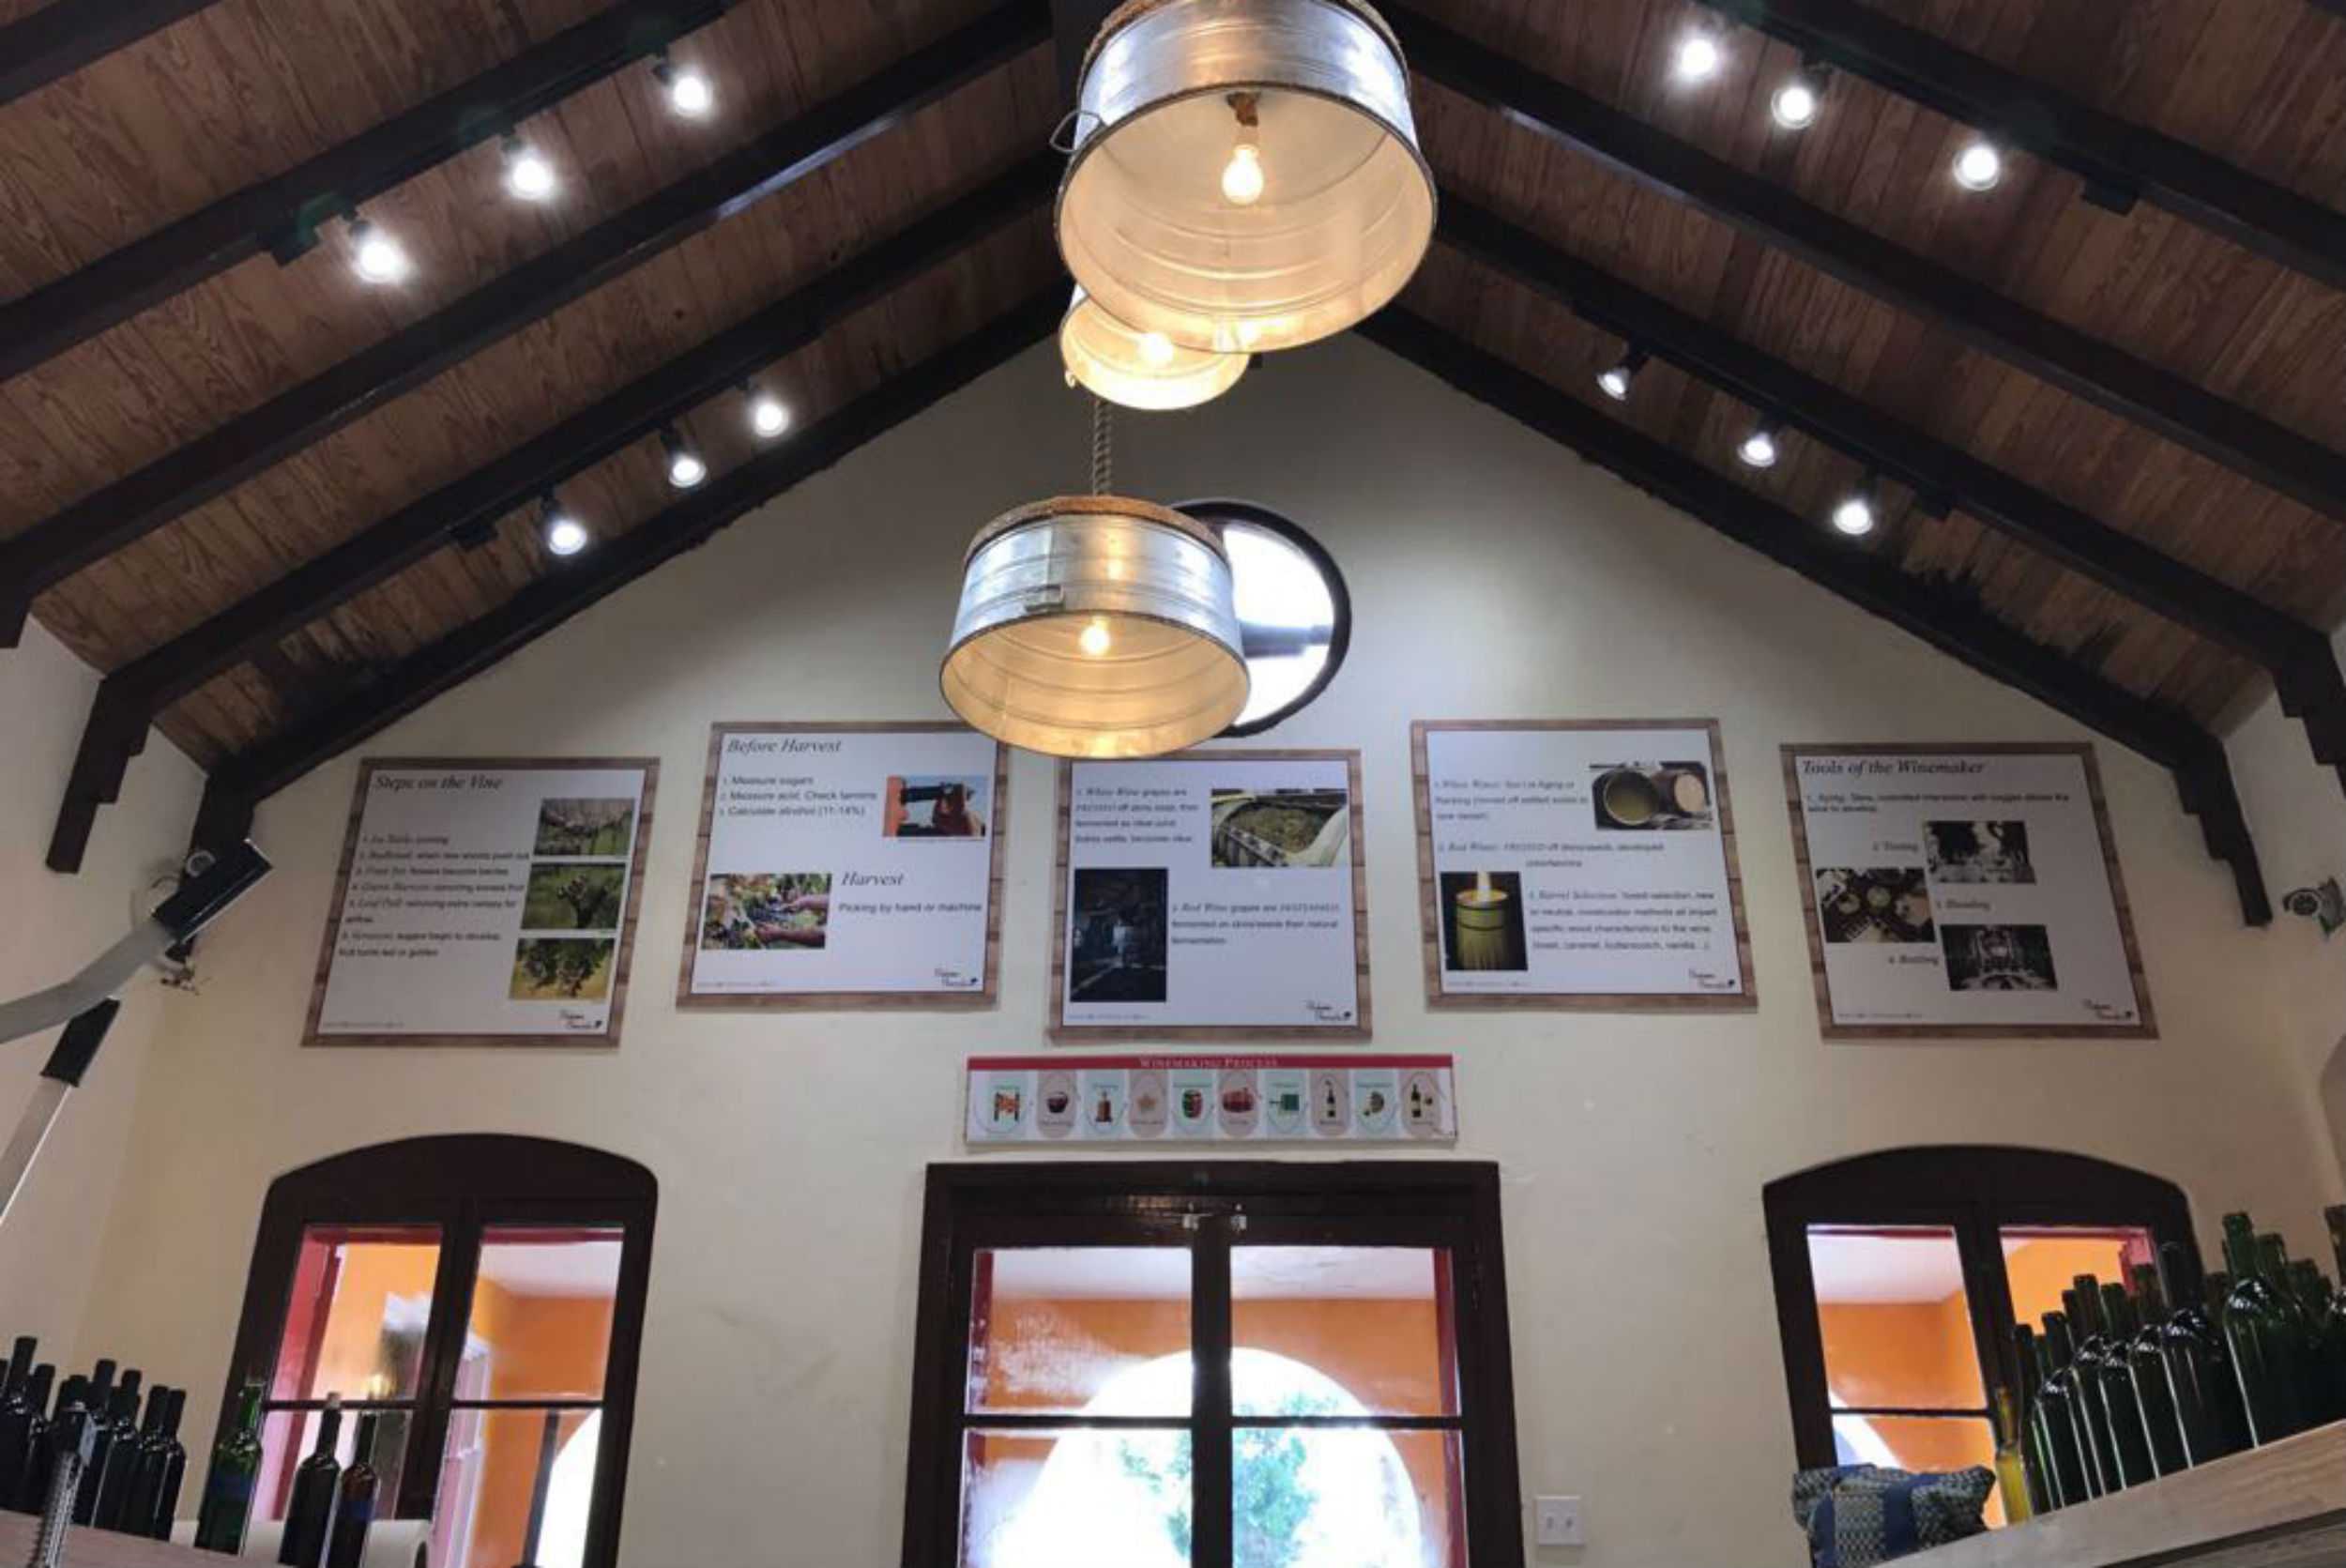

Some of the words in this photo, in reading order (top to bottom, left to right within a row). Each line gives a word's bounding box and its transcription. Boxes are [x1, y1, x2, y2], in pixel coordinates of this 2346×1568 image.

[727, 738, 778, 754] Before
[781, 738, 842, 753] Harvest
[1802, 760, 1844, 773] Tools
[1847, 759, 1865, 778] of
[1868, 760, 1893, 773] the
[1897, 759, 1985, 774] Winemaker
[441, 774, 465, 789] the
[841, 871, 905, 886] Harvest
[839, 902, 876, 915] Picking
[879, 902, 892, 915] by
[895, 902, 922, 913] hand
[923, 904, 935, 913] or
[937, 902, 982, 913] machine
